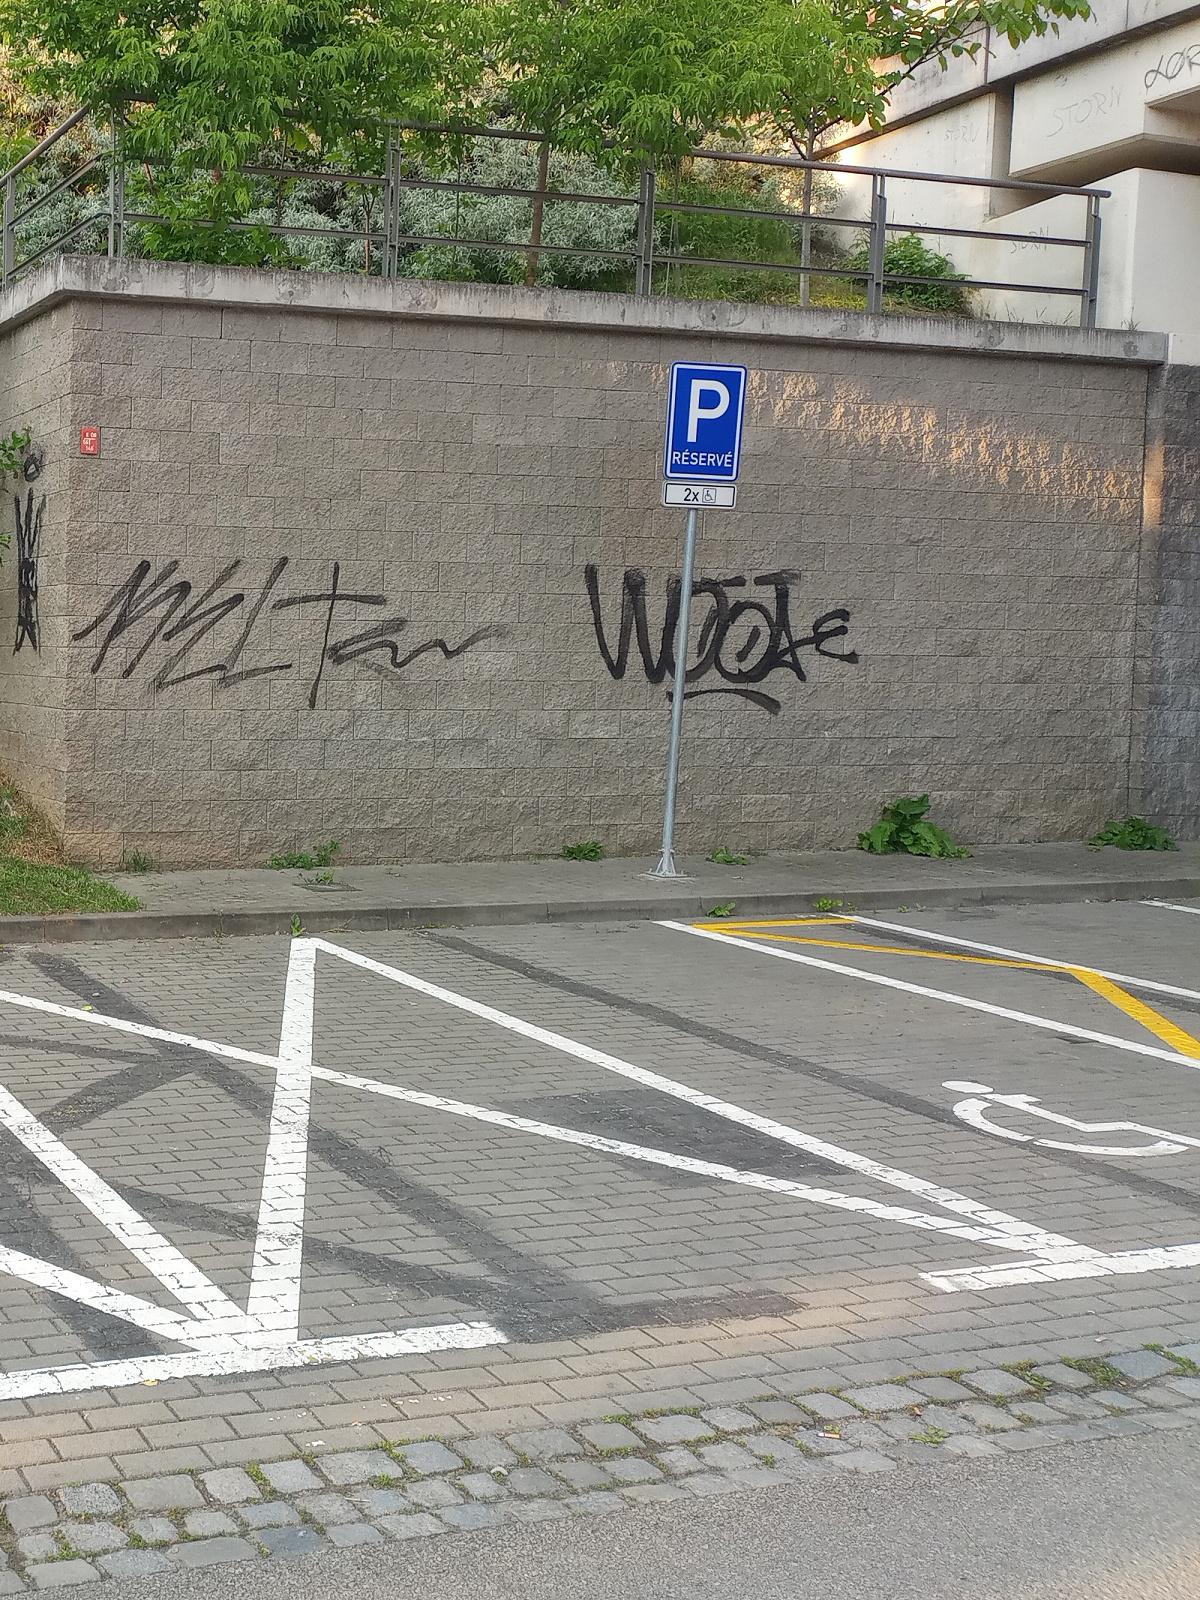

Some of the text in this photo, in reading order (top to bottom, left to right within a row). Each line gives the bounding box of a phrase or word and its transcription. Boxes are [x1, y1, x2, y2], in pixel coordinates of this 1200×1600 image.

[687, 379, 730, 443] P
[672, 449, 733, 468] RÉSERVÉ
[683, 488, 700, 502] 2x
